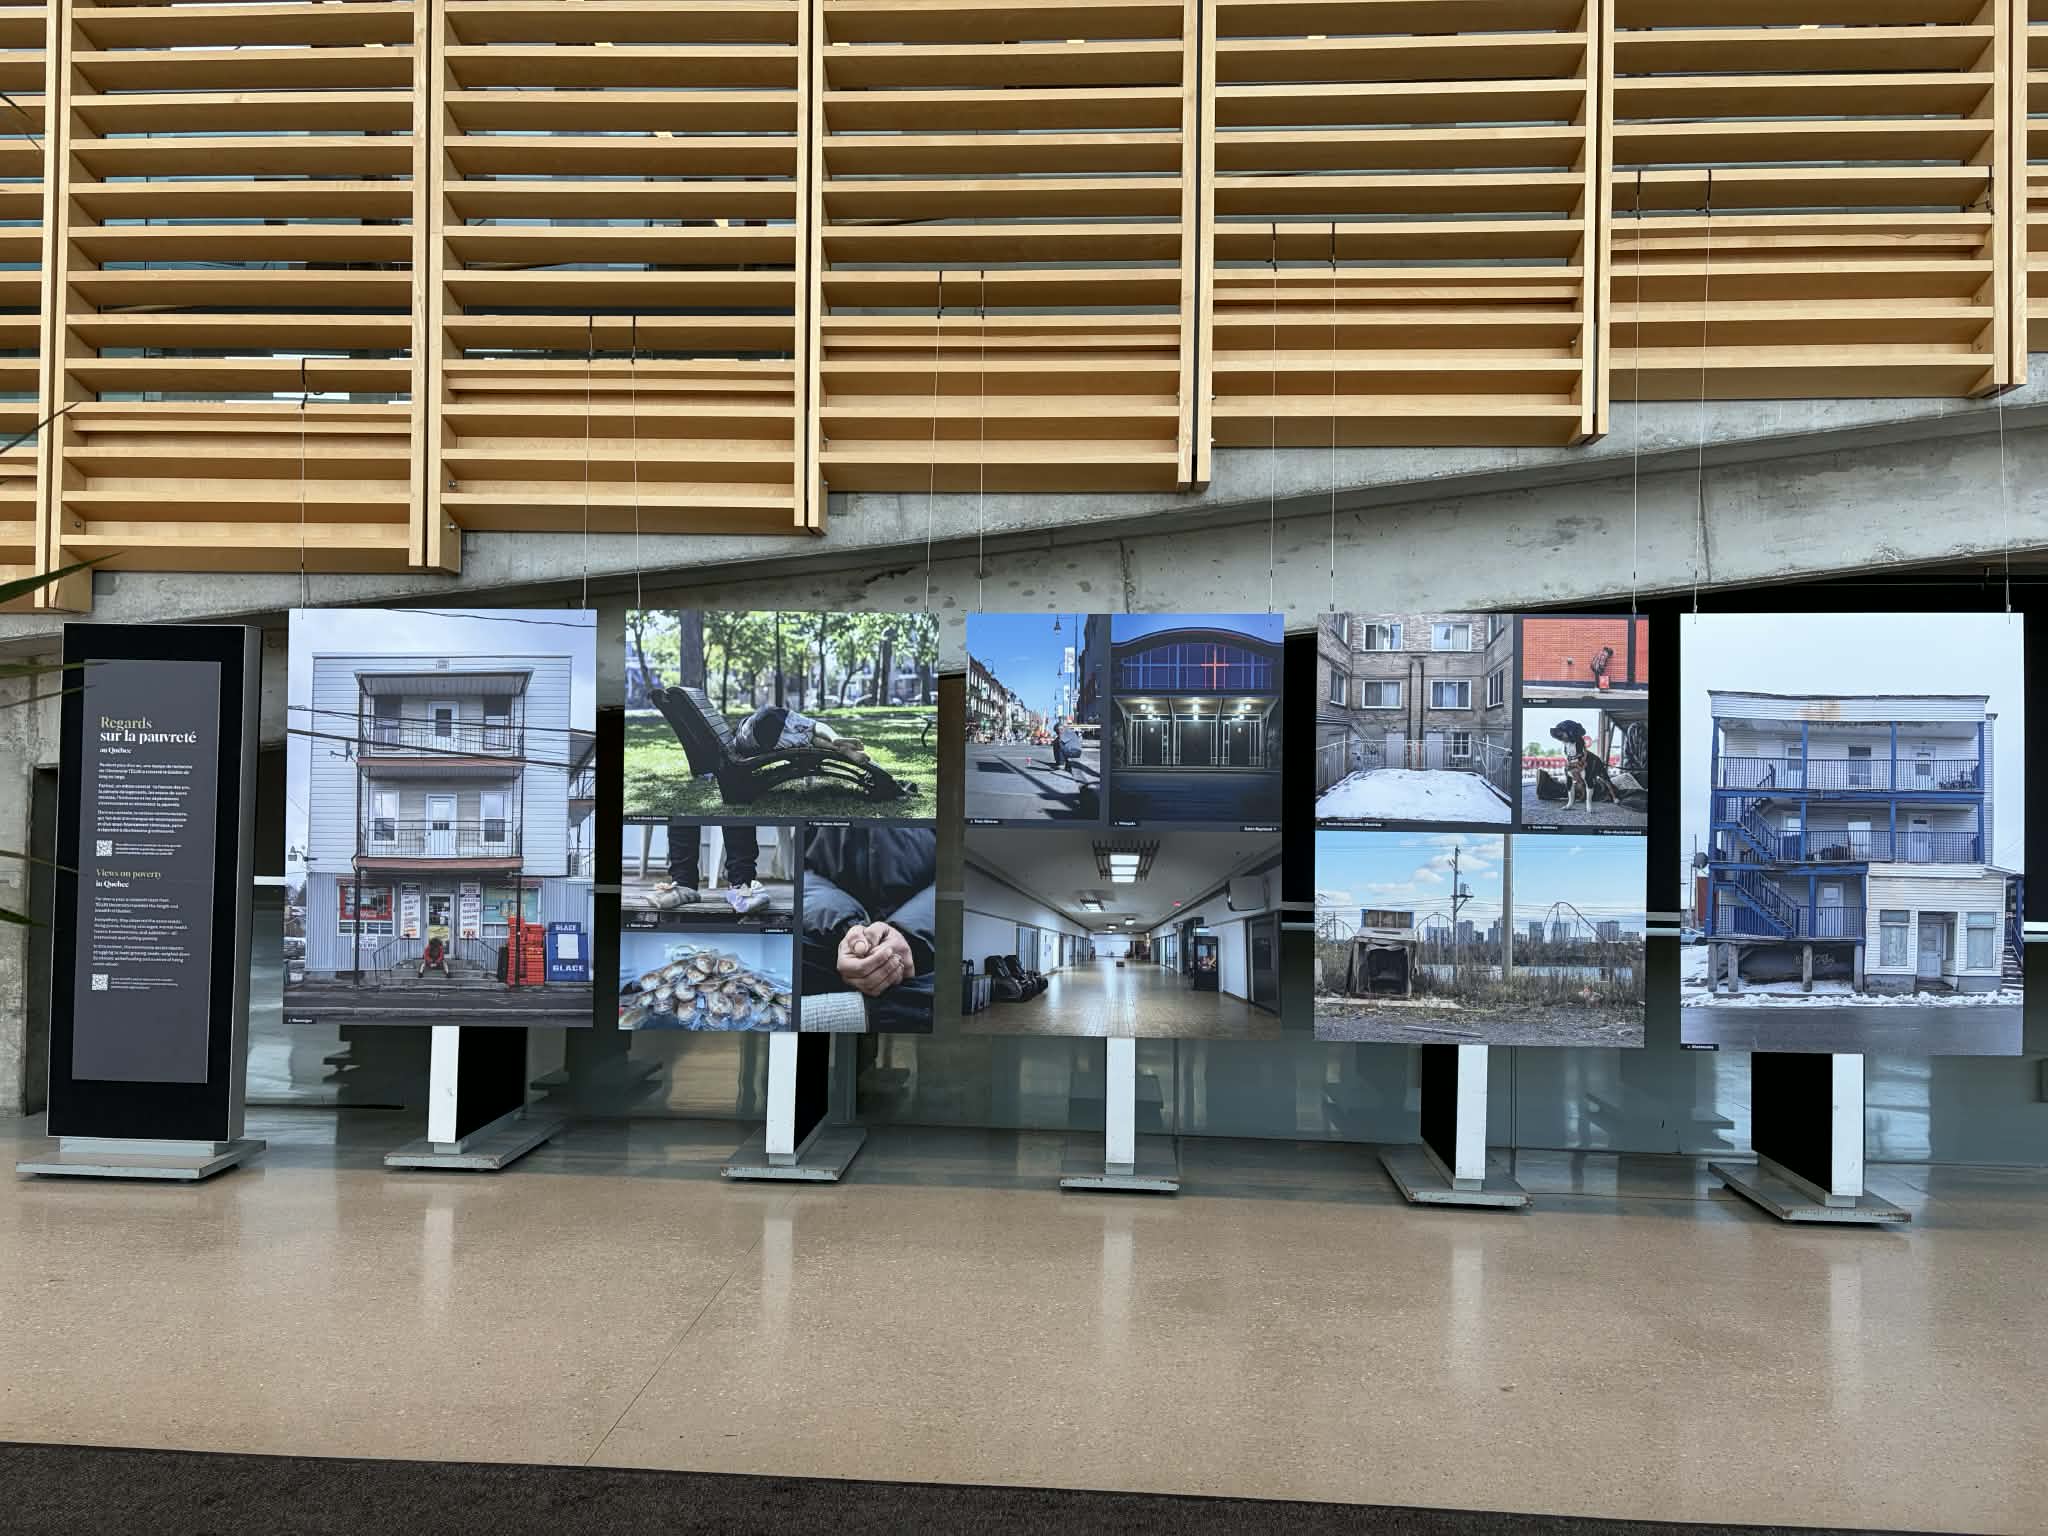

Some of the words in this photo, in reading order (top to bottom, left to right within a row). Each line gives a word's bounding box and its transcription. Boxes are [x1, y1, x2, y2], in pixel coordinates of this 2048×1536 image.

[101, 716, 153, 730] Regards
[100, 731, 122, 742] sur
[124, 730, 136, 742] la
[139, 731, 198, 745] pauvreté
